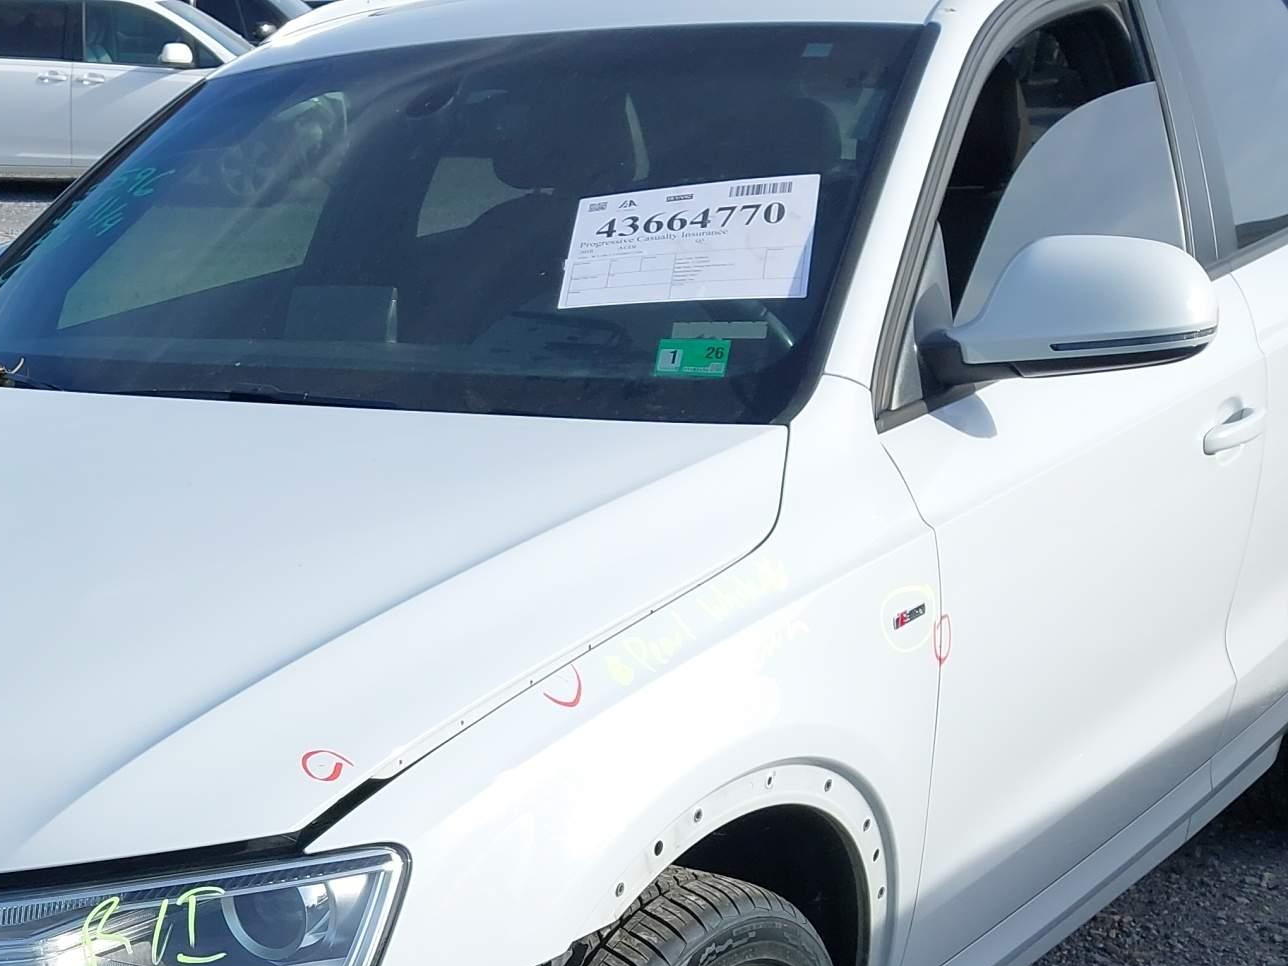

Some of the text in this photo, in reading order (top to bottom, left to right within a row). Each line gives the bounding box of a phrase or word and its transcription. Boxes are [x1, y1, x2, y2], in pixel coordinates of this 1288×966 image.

[595, 202, 786, 238] 43664770
[579, 228, 728, 249] Progressive Casualty Insurance
[669, 350, 678, 364] 1
[705, 346, 725, 359] 26
